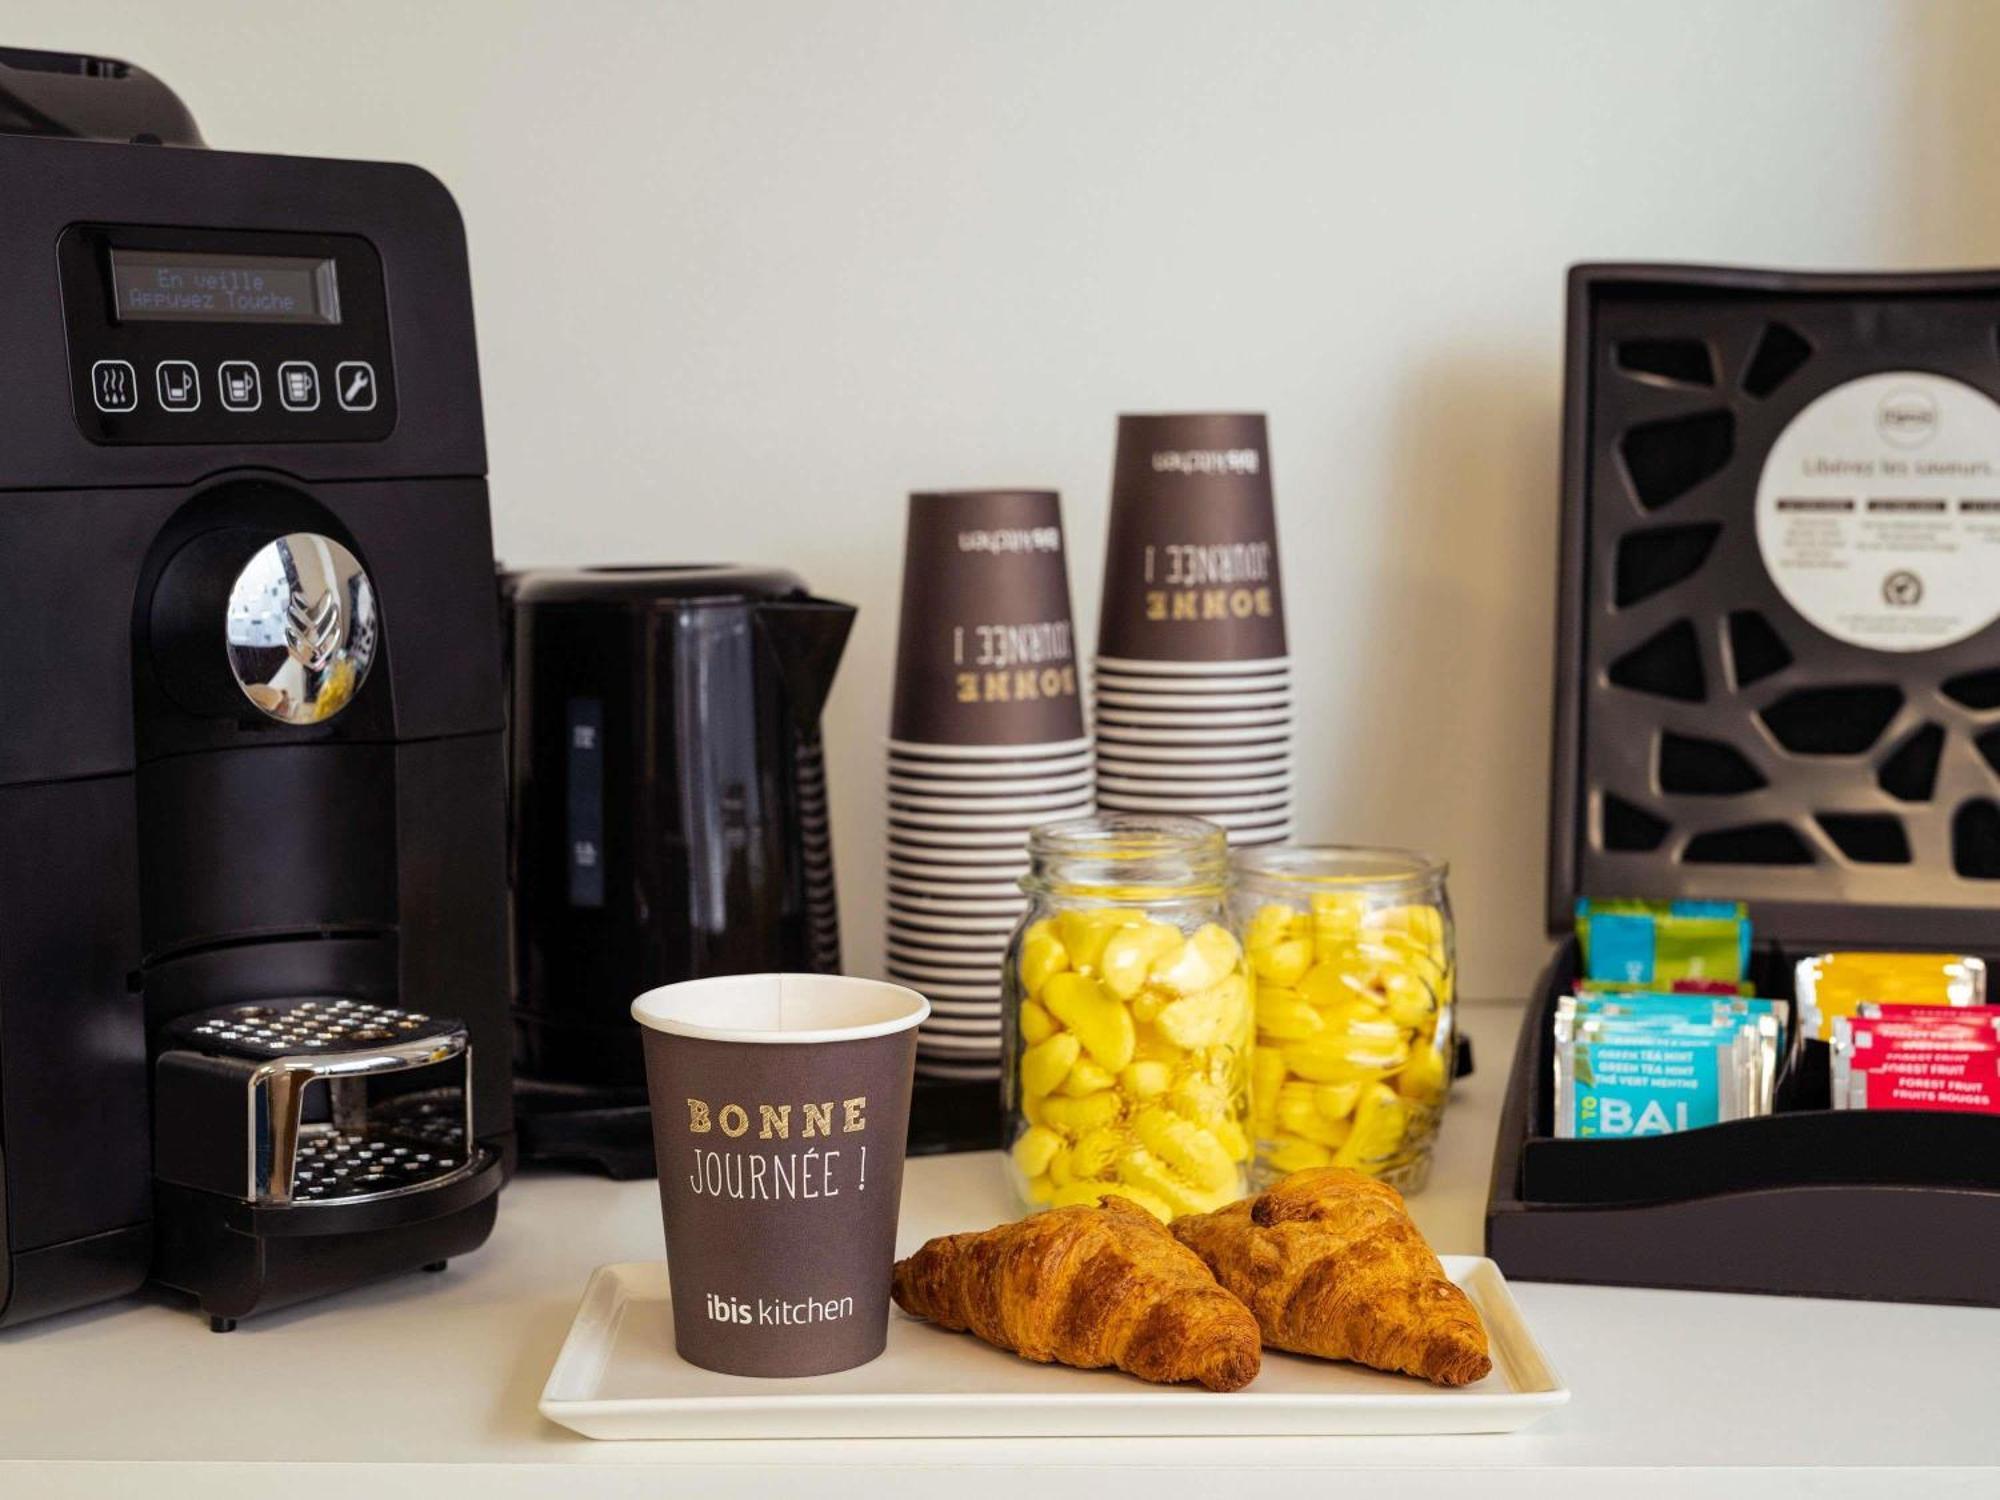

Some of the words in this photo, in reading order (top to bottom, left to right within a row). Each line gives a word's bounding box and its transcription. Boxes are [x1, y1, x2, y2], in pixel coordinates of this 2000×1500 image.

[158, 268, 183, 288] En
[195, 270, 264, 290] veille
[226, 291, 295, 311] Touche
[1598, 1062, 1638, 1074] GREEN
[1641, 1063, 1663, 1075] TEA
[1665, 1065, 1695, 1076] MINT
[1930, 1064, 1966, 1076] FRUIT
[1619, 1076, 1649, 1087] VERT
[1898, 1077, 1946, 1090] FOREST
[1947, 1080, 1983, 1093] FRUIT
[1892, 1089, 1936, 1102] FRUITS
[1938, 1092, 1991, 1106] ROUGES
[687, 1097, 867, 1139] BONNE
[690, 1147, 840, 1201] JOURNÉE
[858, 1146, 867, 1192] !
[706, 1293, 753, 1325] ibis
[759, 1296, 853, 1326] kitchen
